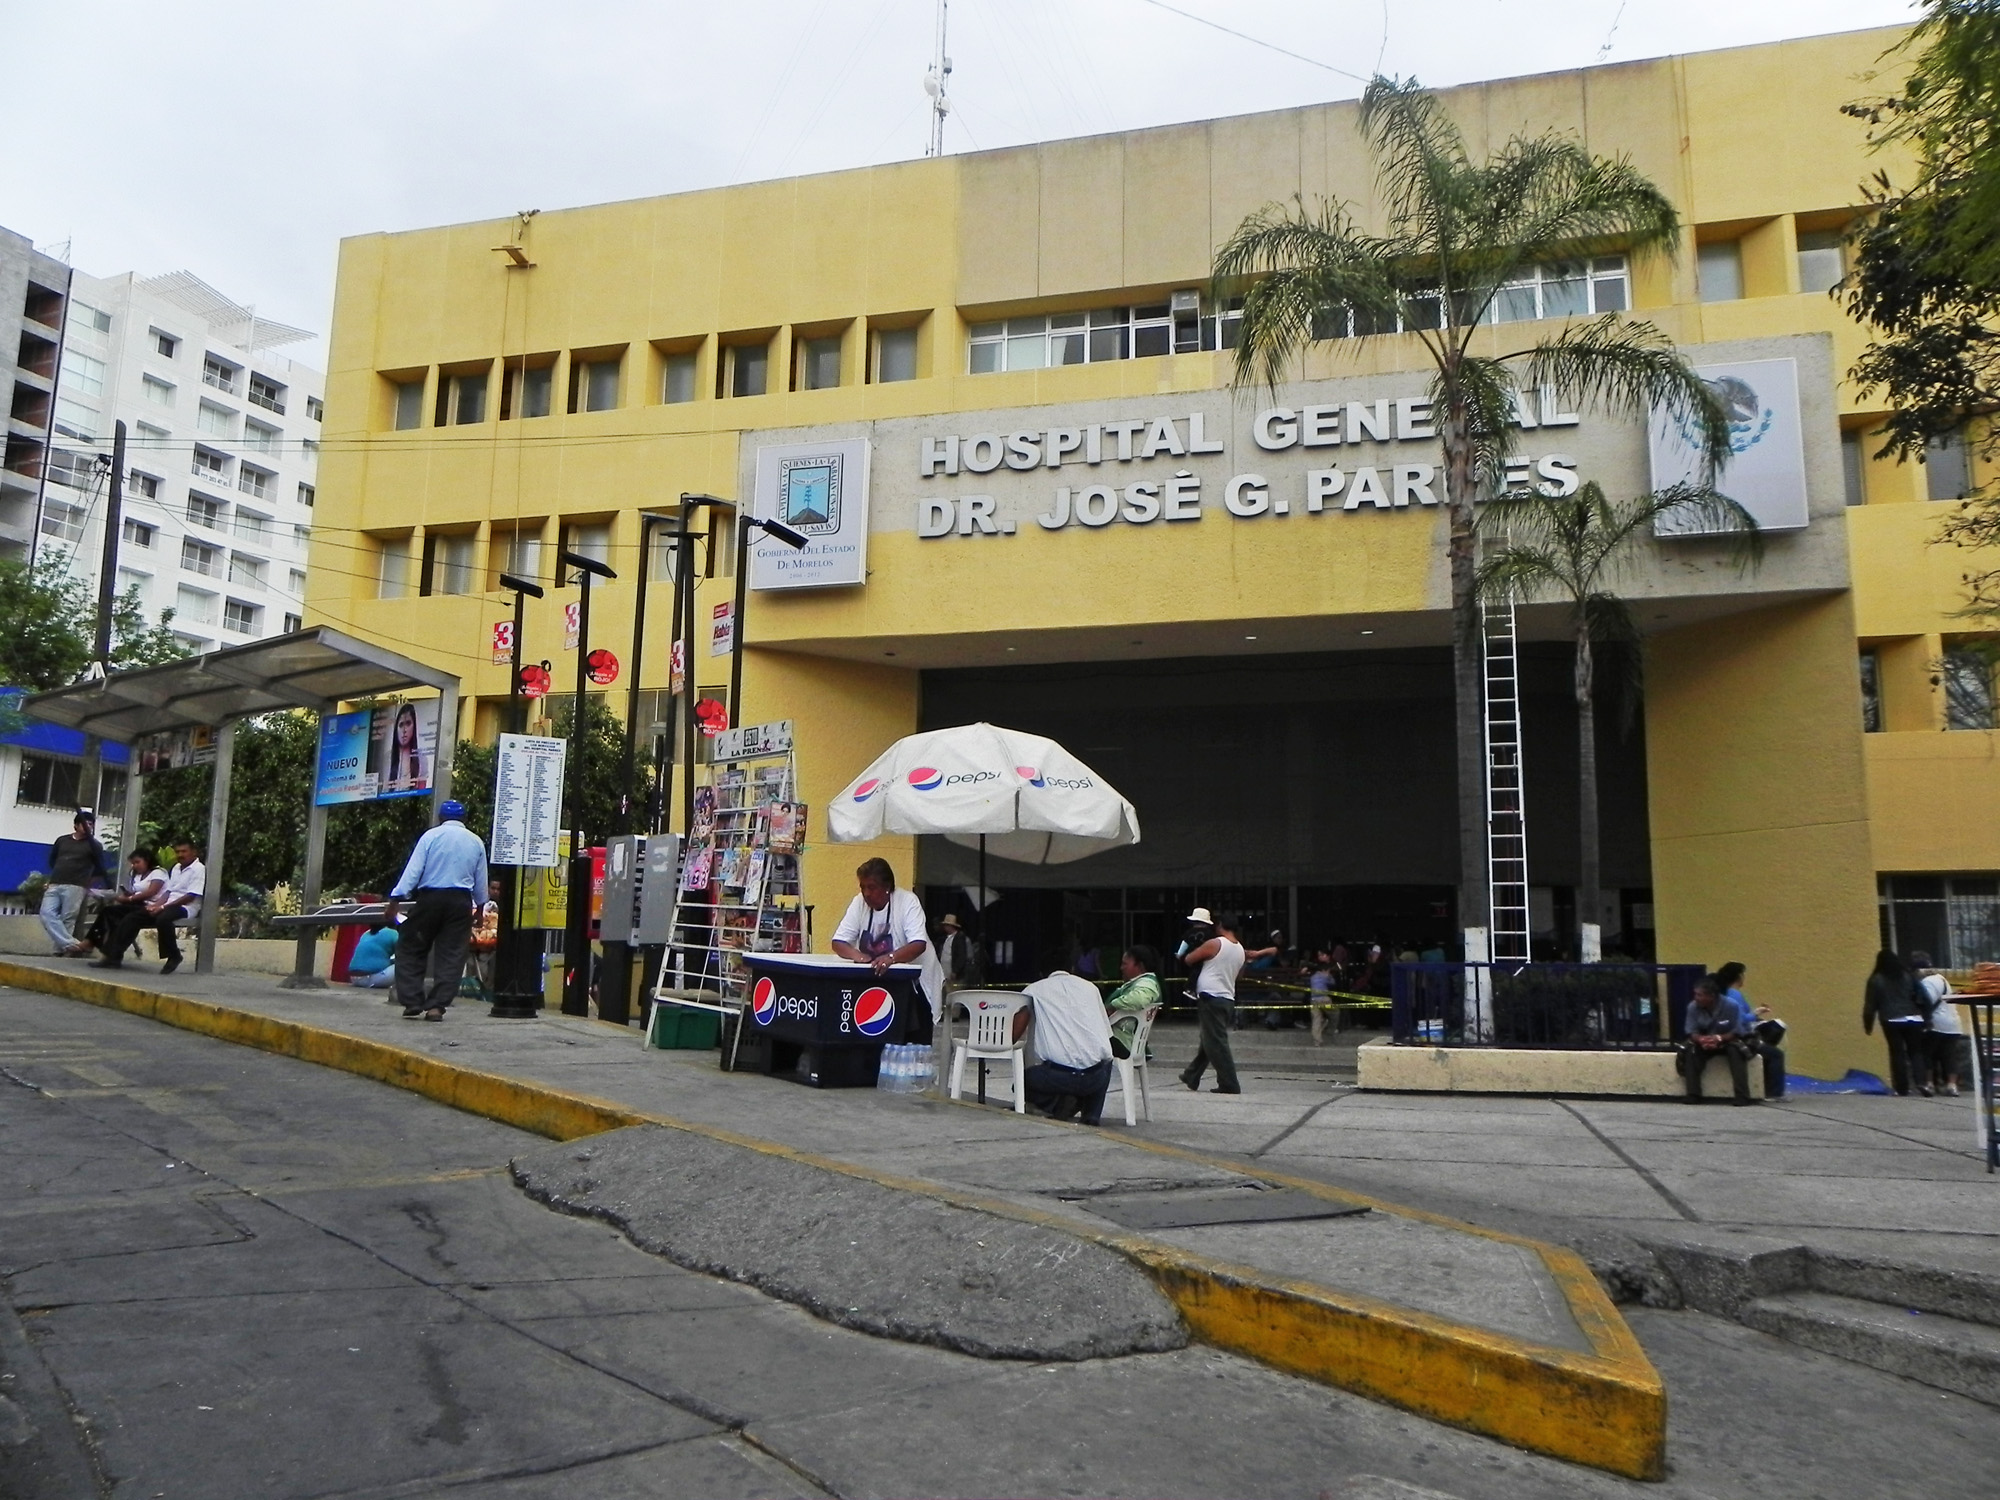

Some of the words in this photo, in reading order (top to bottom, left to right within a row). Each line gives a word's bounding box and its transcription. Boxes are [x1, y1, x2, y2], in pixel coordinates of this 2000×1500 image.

[920, 411, 1223, 477] HOSPITAL
[1253, 383, 1579, 451] GENEAL
[918, 494, 1017, 539] DR.
[1037, 469, 1202, 531] JOSÉ
[1224, 473, 1288, 517] G.
[1306, 452, 1580, 513] PARES
[822, 544, 856, 554] ESTADO
[792, 559, 834, 569] MORELOS
[327, 757, 358, 771] NUEVO
[946, 771, 1002, 787] pepsi
[1046, 776, 1094, 791] pepsi
[777, 996, 818, 1020] pepsi
[840, 989, 852, 1033] pepsi
